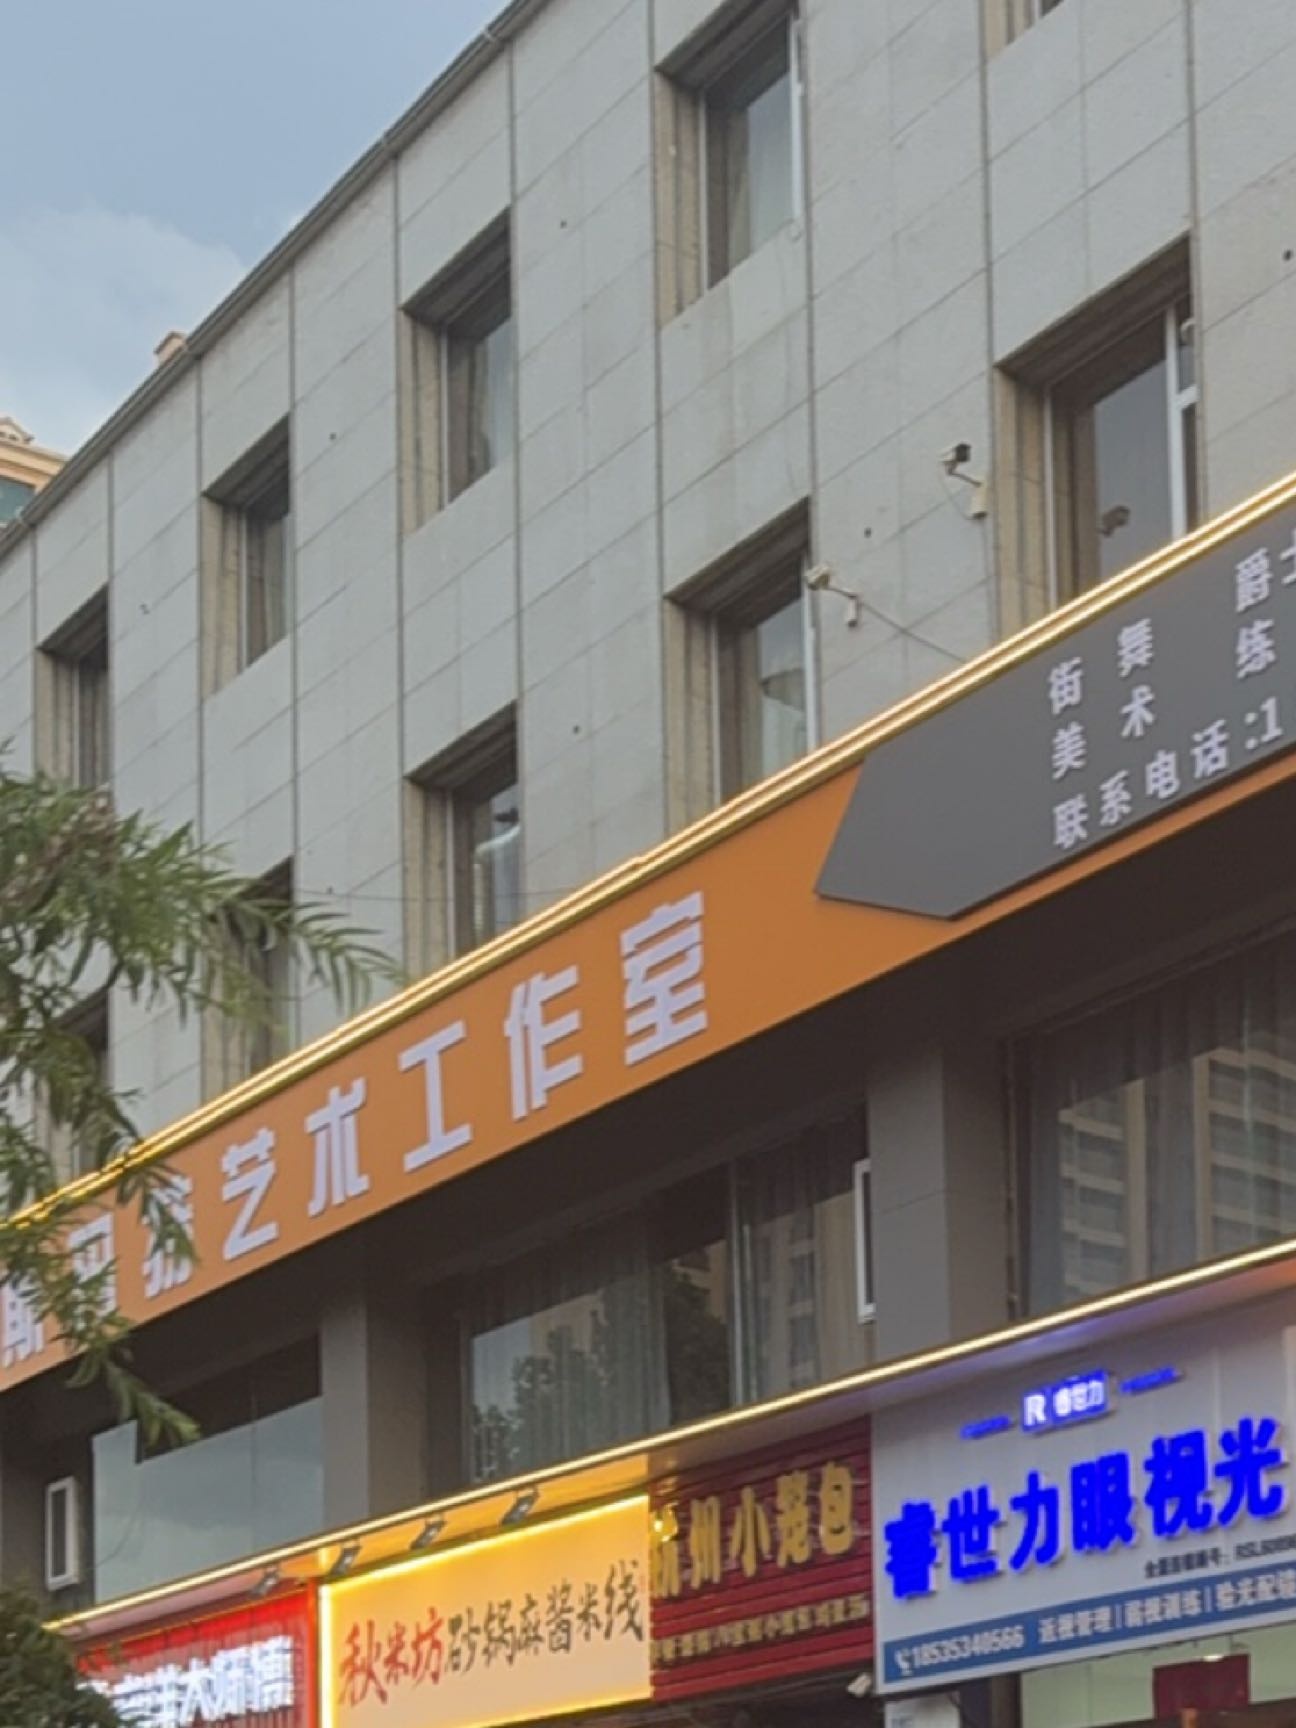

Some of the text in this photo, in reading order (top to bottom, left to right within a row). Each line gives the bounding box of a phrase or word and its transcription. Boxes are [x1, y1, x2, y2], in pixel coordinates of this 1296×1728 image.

[1048, 618, 1153, 716] 街舞
[1051, 688, 1155, 779] 美术
[884, 1416, 1286, 1600] 睿世力眼视光
